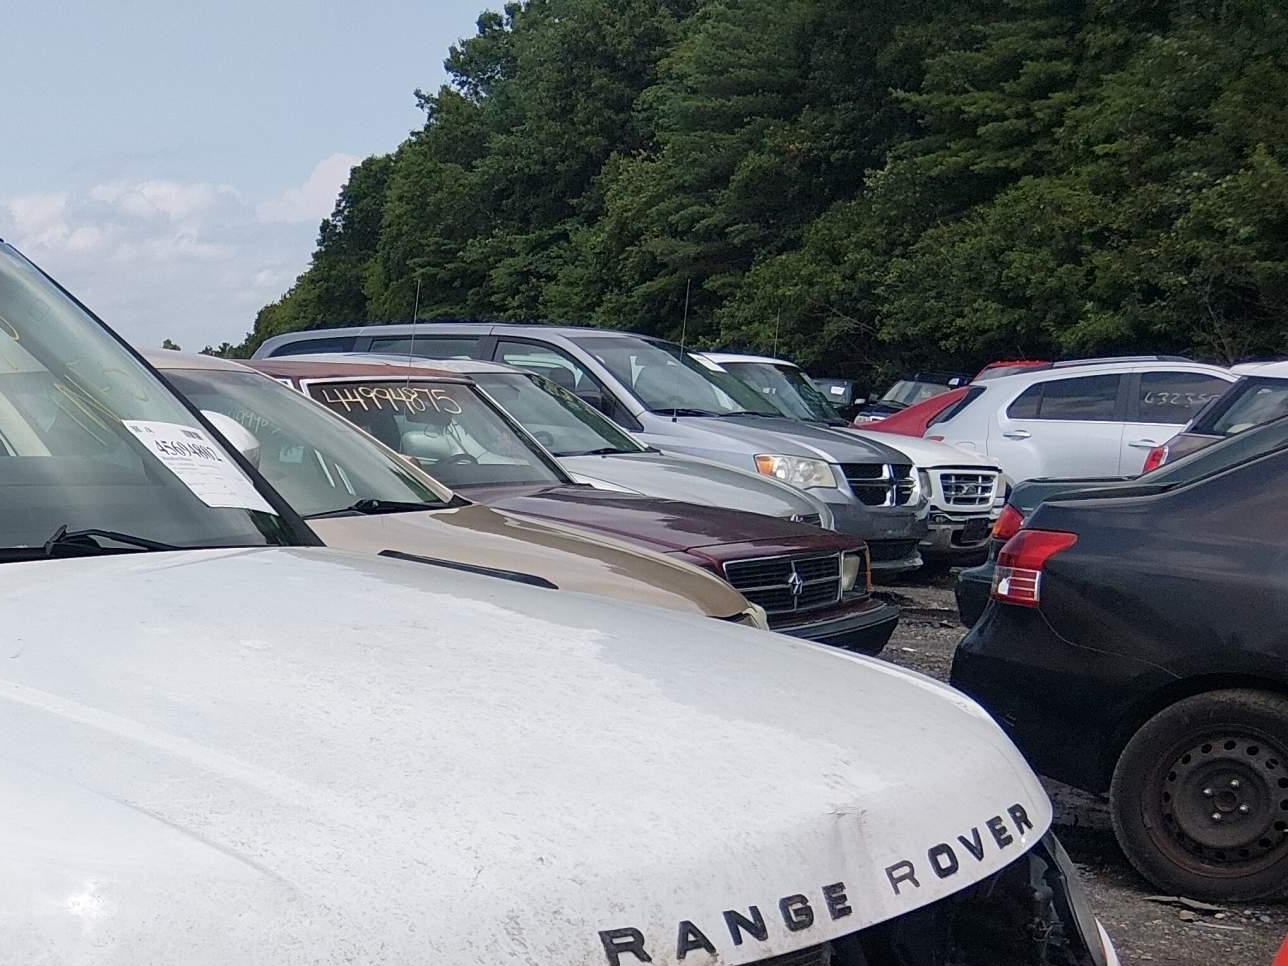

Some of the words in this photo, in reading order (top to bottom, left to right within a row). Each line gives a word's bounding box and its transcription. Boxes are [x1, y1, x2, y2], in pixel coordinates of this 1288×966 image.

[322, 386, 462, 415] 44994875
[155, 439, 223, 462] 45694802
[884, 803, 1033, 895] ROVER
